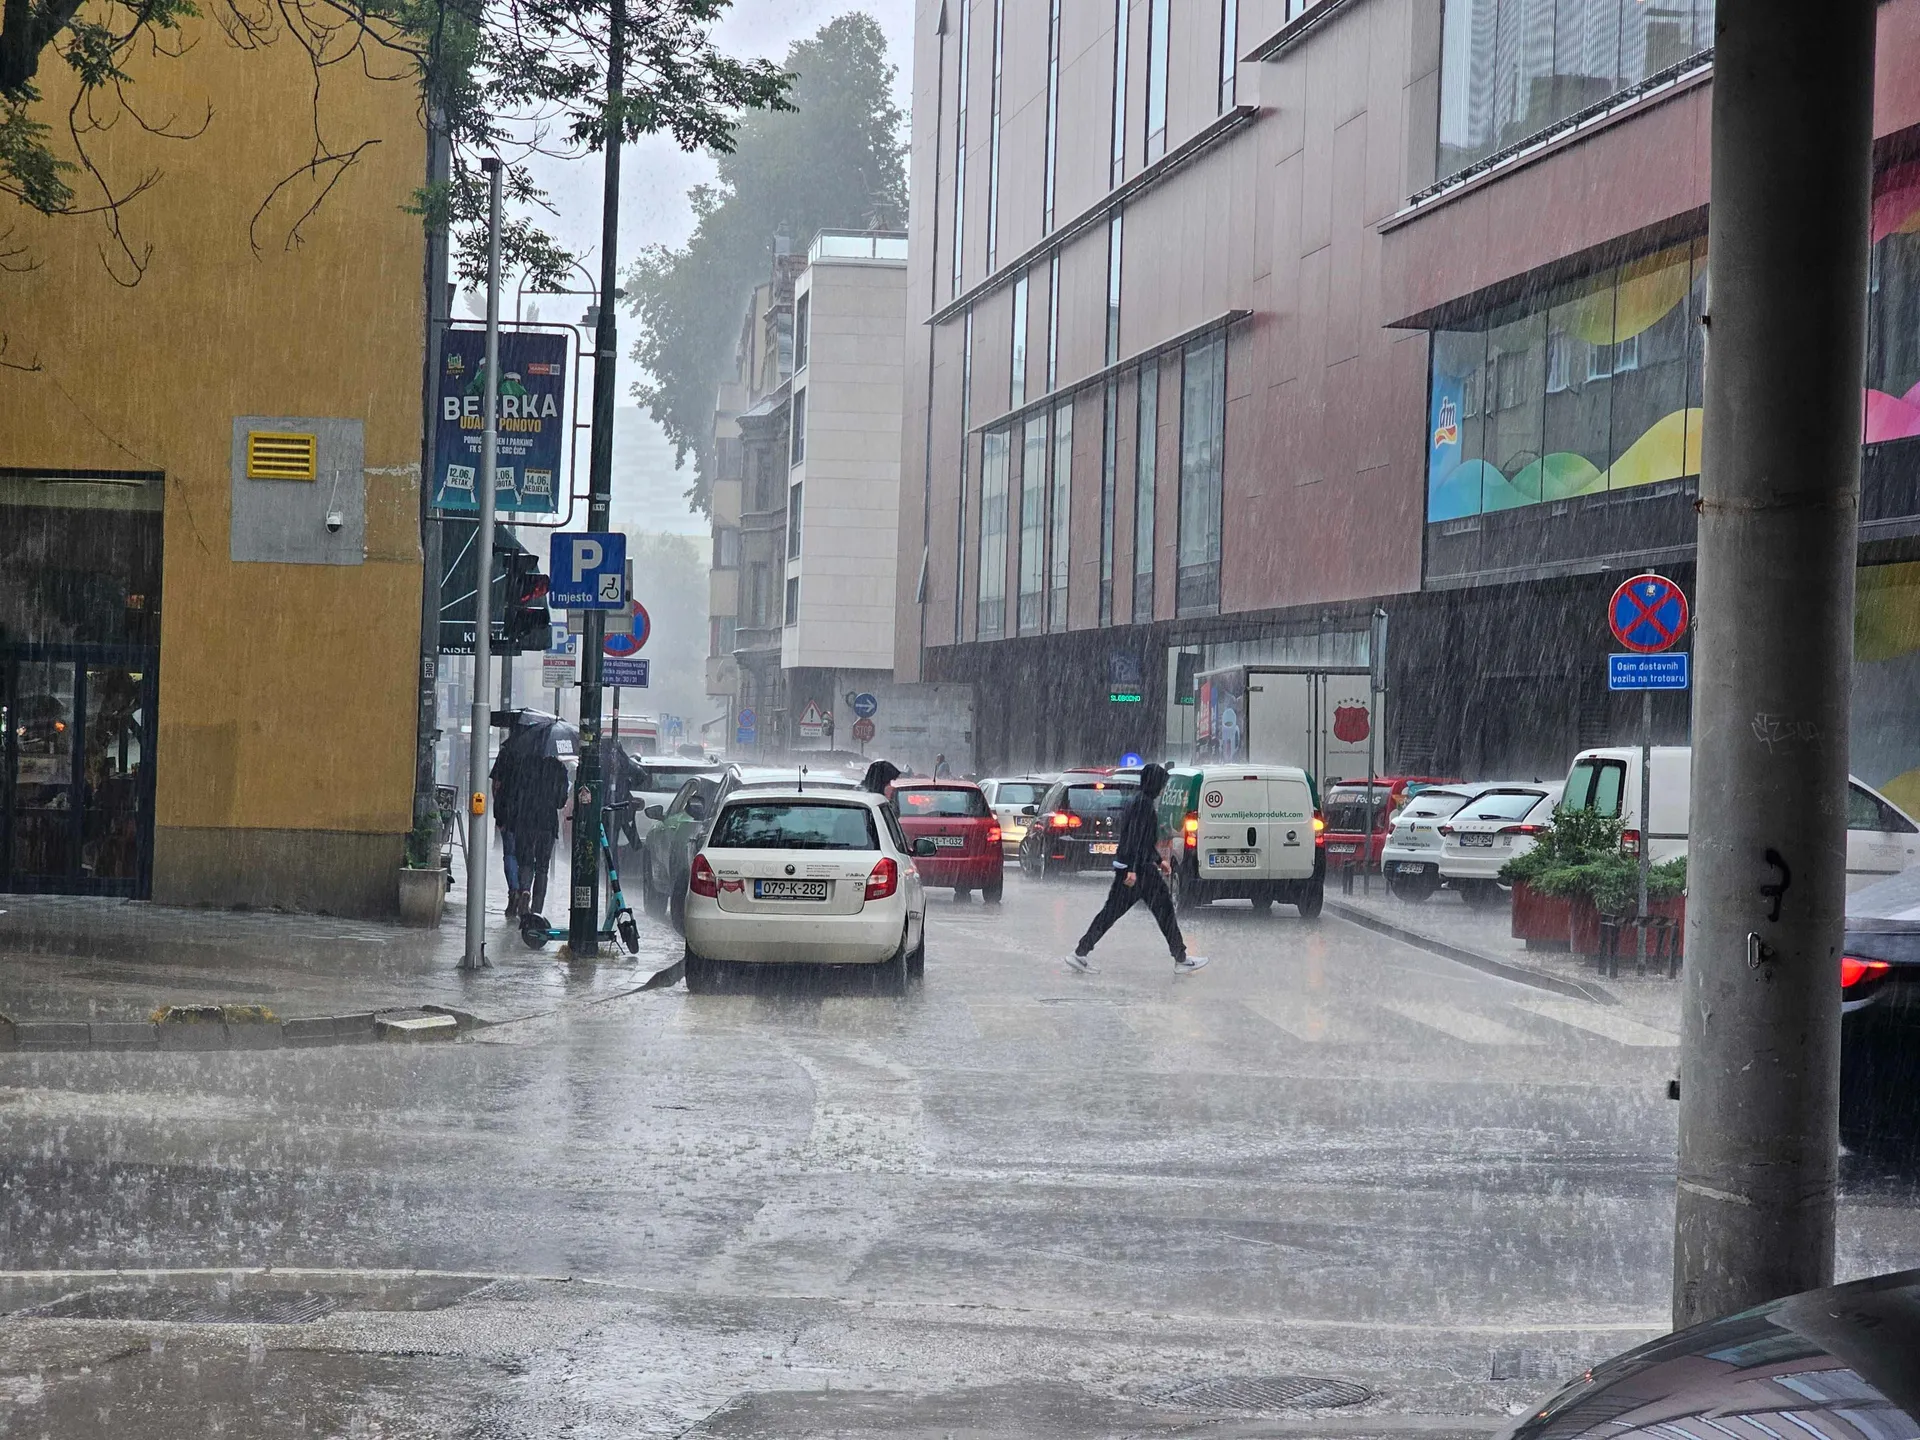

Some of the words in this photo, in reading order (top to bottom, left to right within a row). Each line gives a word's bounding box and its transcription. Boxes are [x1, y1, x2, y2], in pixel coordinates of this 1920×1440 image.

[443, 393, 558, 420] BERKA
[1440, 399, 1456, 428] dm
[499, 417, 541, 433] PONOVO
[449, 467, 471, 480] 12.06.
[451, 478, 469, 487] PETAK
[526, 475, 549, 486] 14.06.
[571, 539, 603, 583] P
[558, 592, 593, 603] mjesto
[1617, 662, 1637, 671] Osim
[1639, 661, 1679, 671] dostavnih
[1612, 674, 1636, 683] vozila
[1650, 674, 1685, 683] trotoaru
[855, 725, 873, 733] STOP
[1208, 794, 1220, 804] 80
[1210, 811, 1304, 820] www.mlijekoprodukt.com
[1214, 855, 1255, 864] E83-J-930
[763, 882, 825, 896] 079-K-282
